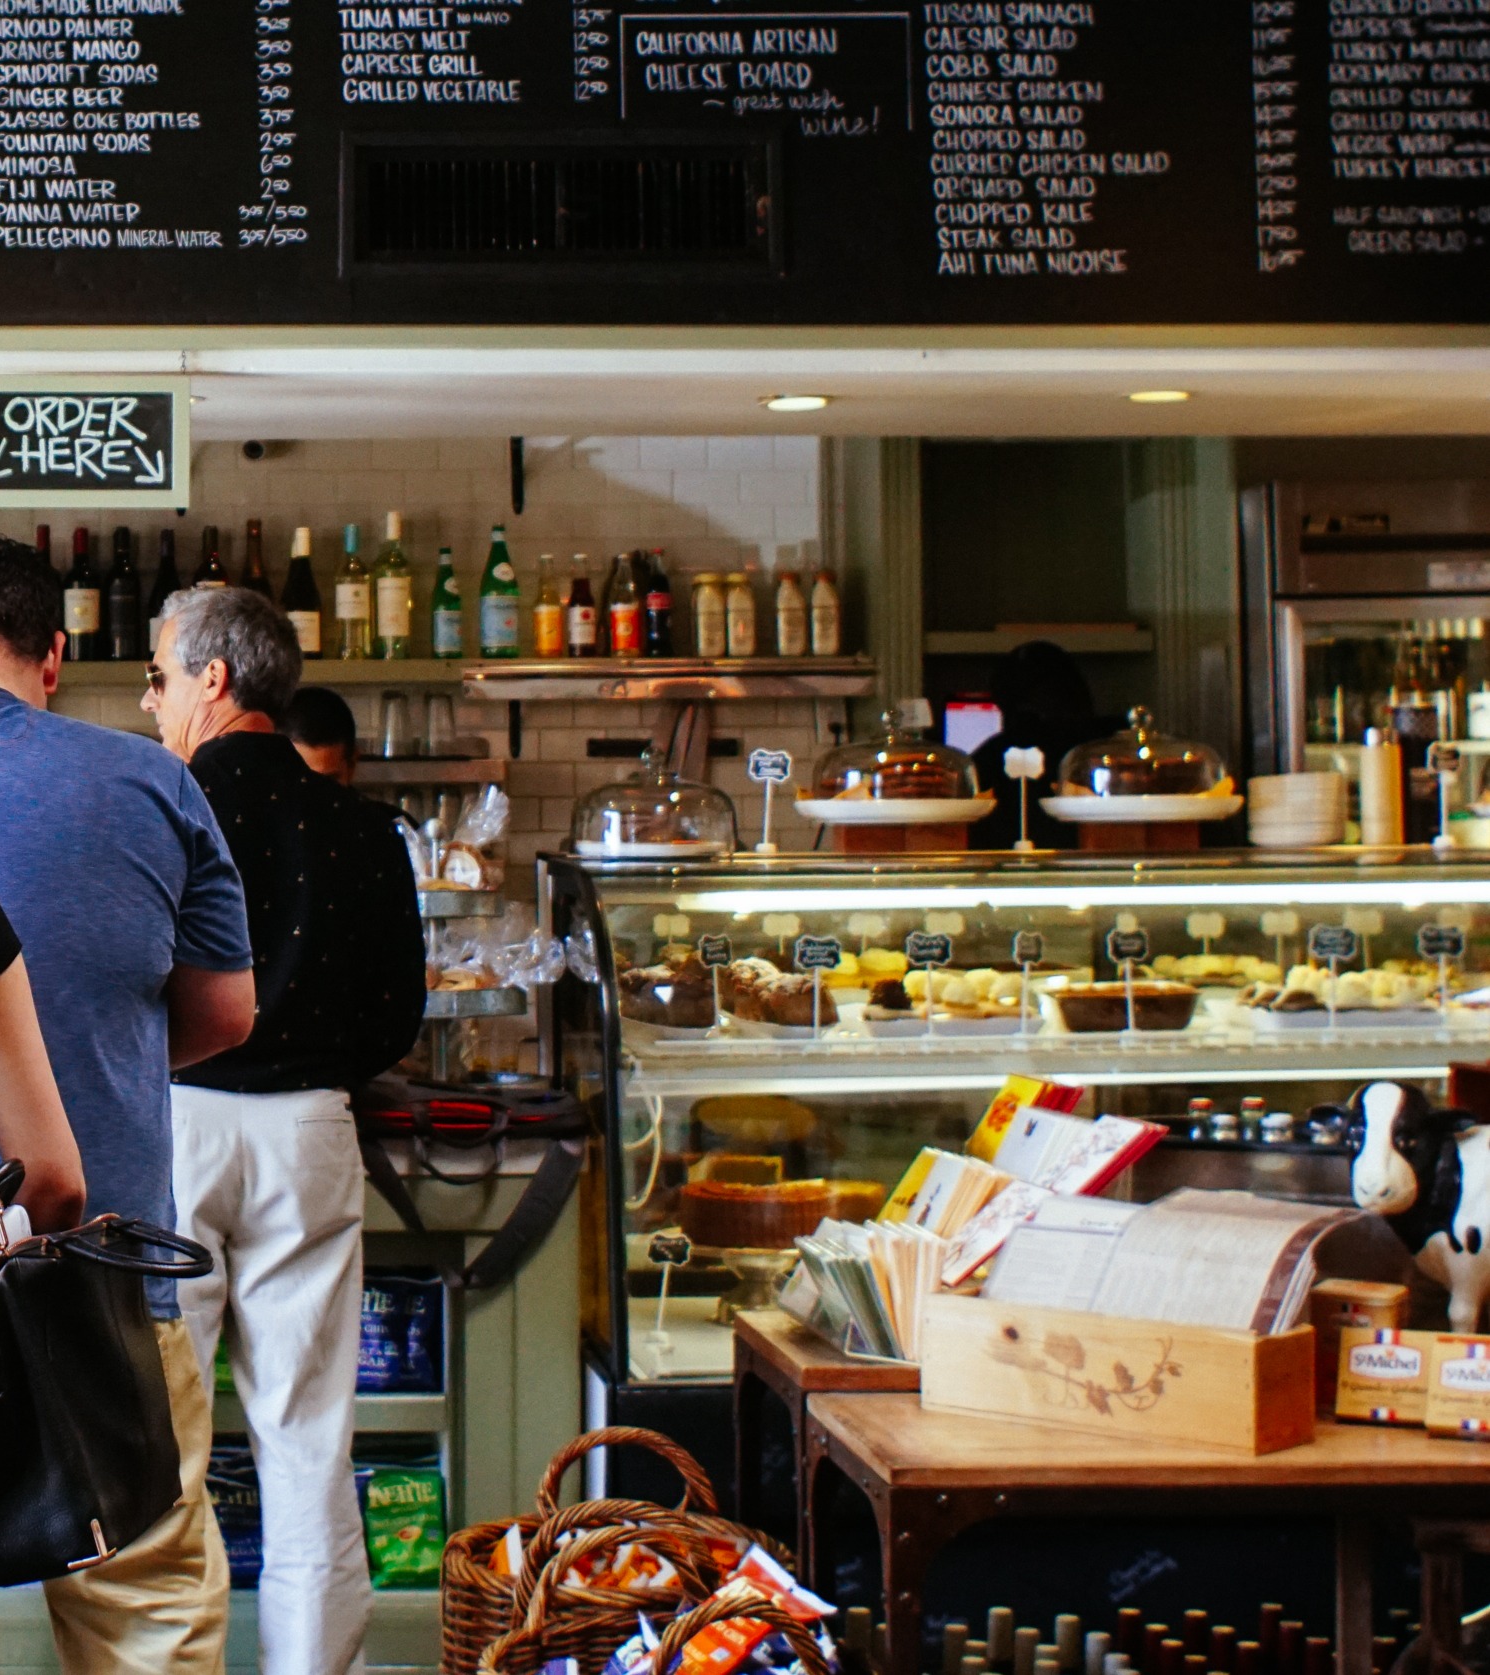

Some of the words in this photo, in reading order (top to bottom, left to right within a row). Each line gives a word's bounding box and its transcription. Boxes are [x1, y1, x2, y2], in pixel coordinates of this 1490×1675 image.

[339, 8, 393, 29] TUNA
[398, 8, 452, 28] MELT
[472, 12, 510, 24] MAYO
[924, 3, 1001, 24] TUSCAN
[1005, 3, 1093, 24] SPINACH
[64, 18, 133, 38] PALMER
[924, 26, 1009, 50] CAESAR
[1014, 26, 1077, 50] SALAD
[73, 40, 140, 61] MANGO
[340, 32, 414, 51] TURKEY
[421, 31, 469, 50] MELT
[636, 31, 743, 55] CALIFORNIA
[753, 28, 837, 53] ARTISAN
[98, 64, 157, 84] SODAS
[341, 54, 424, 75] CAPRESE
[428, 55, 482, 76] GRILL
[645, 62, 730, 90] CHEESE
[738, 62, 812, 89] BOARD
[926, 54, 990, 78] COBB
[997, 53, 1057, 76] SALAD
[73, 87, 123, 107] BEER
[343, 79, 418, 102] GRILLED
[423, 80, 520, 101] VEGETABLE
[734, 94, 783, 115] great
[789, 88, 844, 110] with
[927, 82, 1011, 102] CHINESE
[1017, 81, 1103, 101] CHICKEN
[72, 112, 121, 130] COKE
[125, 112, 200, 130] BOTTLES
[930, 104, 1014, 126] SONORA
[1019, 106, 1083, 124] SALAD
[93, 133, 150, 152] SODAS
[933, 129, 1022, 150] CHOPPED
[1026, 129, 1086, 150] SALAD
[930, 153, 1013, 174] CURRIED
[1018, 154, 1106, 177] CHICKEN
[1112, 152, 1170, 174] SALAD
[45, 179, 115, 198] WATER
[933, 176, 1023, 199] ORCHARD
[1036, 176, 1097, 197] SALAD
[69, 203, 140, 222] WATER
[935, 202, 1032, 224] CHOPPED
[1042, 202, 1093, 223] KALE
[117, 229, 173, 247] MINERAL
[175, 230, 222, 247] WATER
[937, 226, 999, 249] STEAK
[1011, 228, 1076, 248] SALAD
[938, 251, 975, 274] AHI
[984, 252, 1038, 273] TUNA
[3, 397, 147, 442] ORDER
[10, 435, 132, 479] HERE
